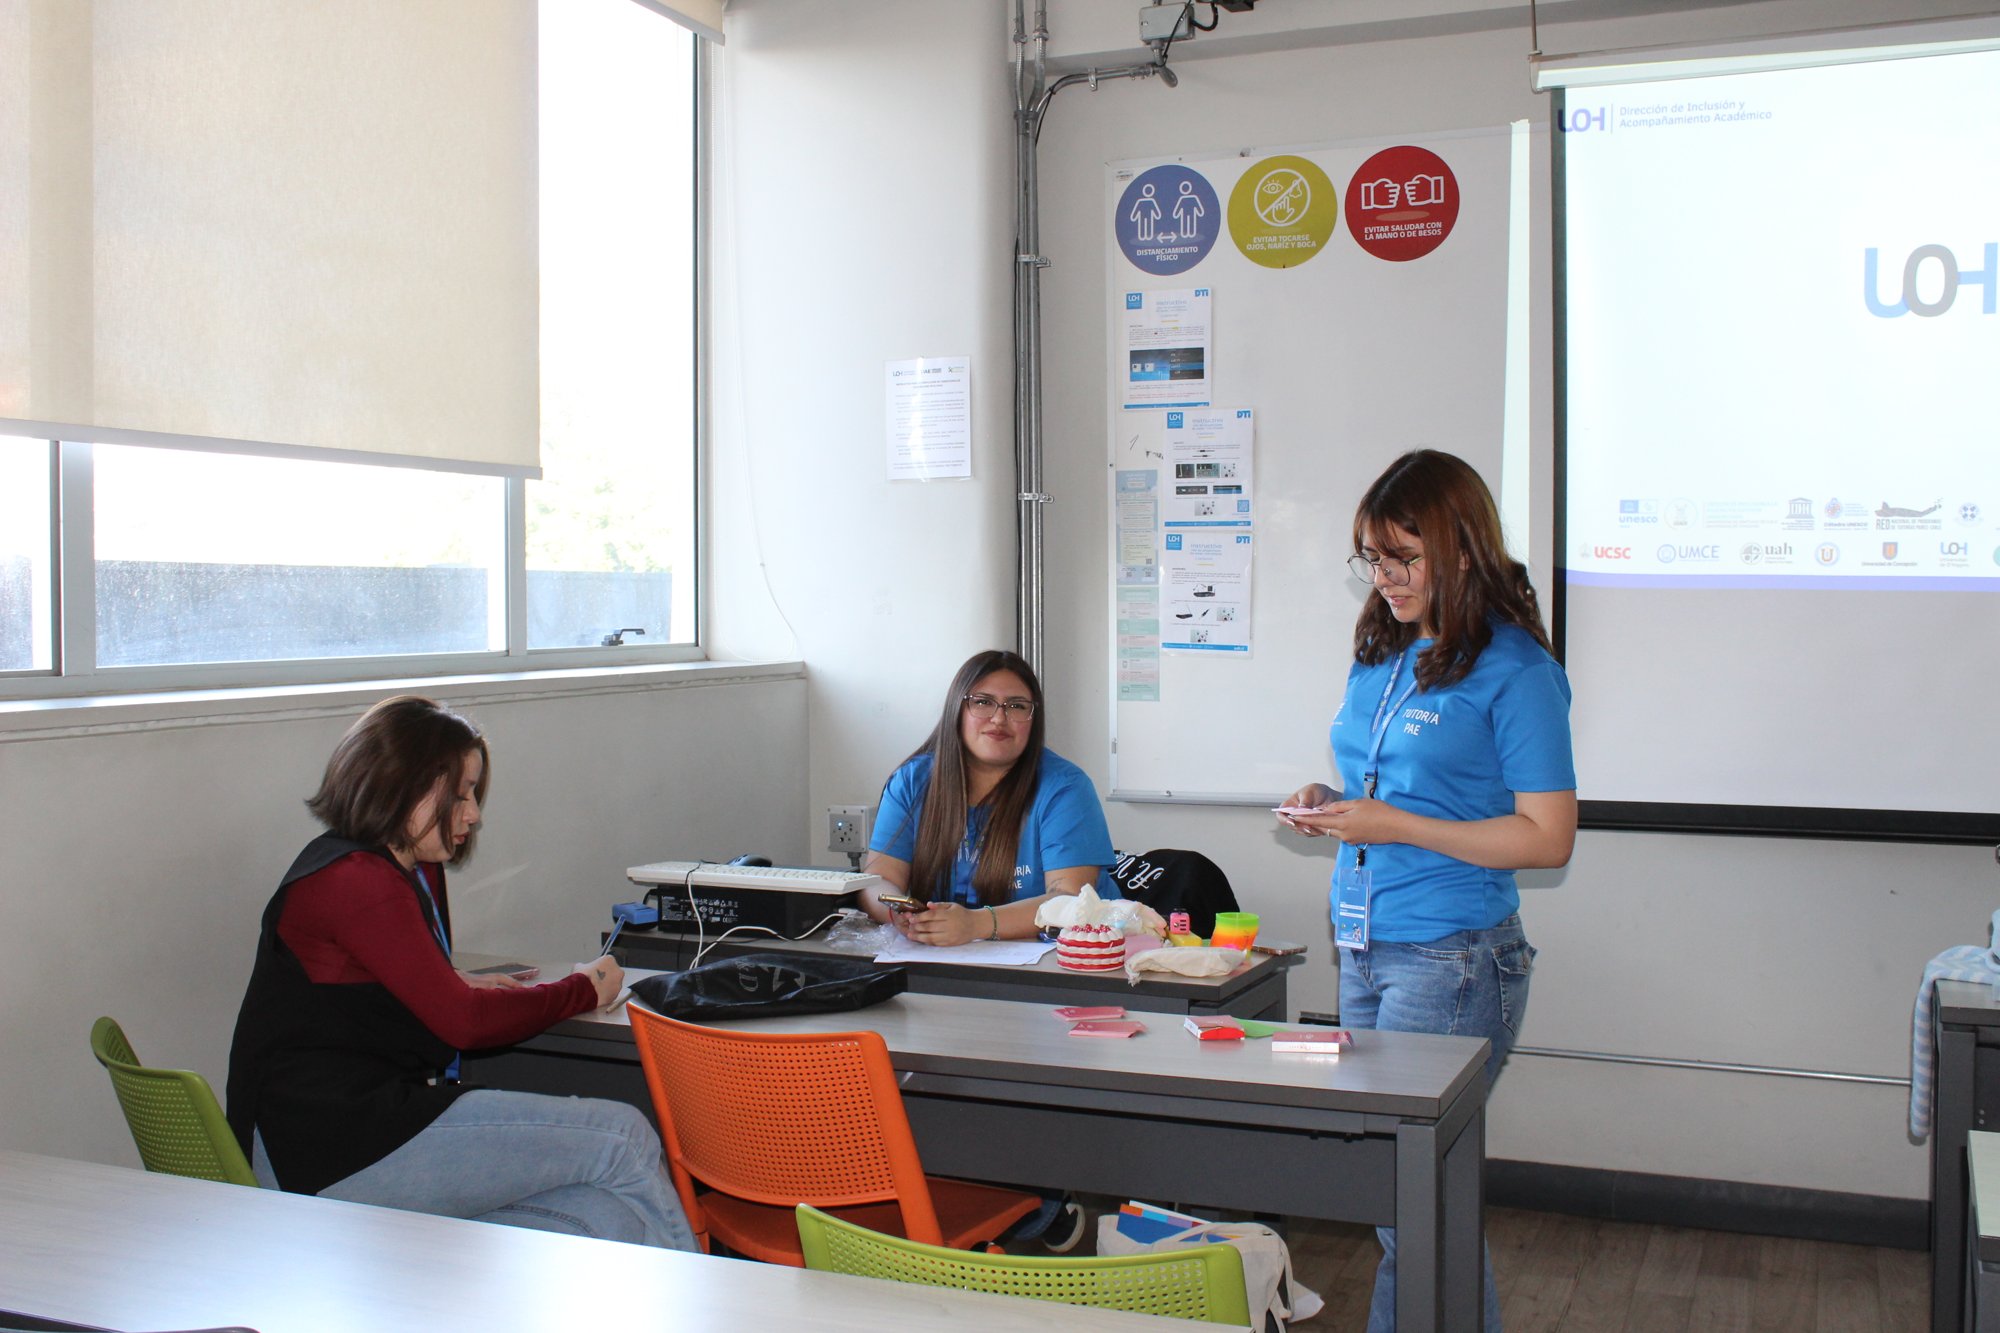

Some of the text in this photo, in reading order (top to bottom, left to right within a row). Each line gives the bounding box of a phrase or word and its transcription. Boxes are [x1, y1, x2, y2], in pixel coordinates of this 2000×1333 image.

[1619, 100, 1746, 117] Dirección de Inclusión y
[1619, 110, 1773, 128] Acompañamiento Académico
[1364, 221, 1443, 234] EVITAR SALUDAR CON
[1365, 233, 1375, 241] LA
[1376, 230, 1399, 239] MANO
[1407, 230, 1417, 238] DE
[1418, 228, 1442, 237] BESOS
[1253, 233, 1310, 243] EVITAR TOCARSE
[1136, 246, 1199, 257] DISTANCIAMIENTO
[1246, 243, 1267, 251] OJOS,
[1291, 241, 1296, 249] Y
[1297, 240, 1317, 248] BOCA
[1618, 516, 1659, 524] unesco
[1593, 546, 1632, 560] UCSC
[1678, 545, 1722, 559] UMCE
[1764, 542, 1793, 556] uah
[1402, 707, 1440, 726] TUTOR/A
[1403, 722, 1421, 736] PAE
